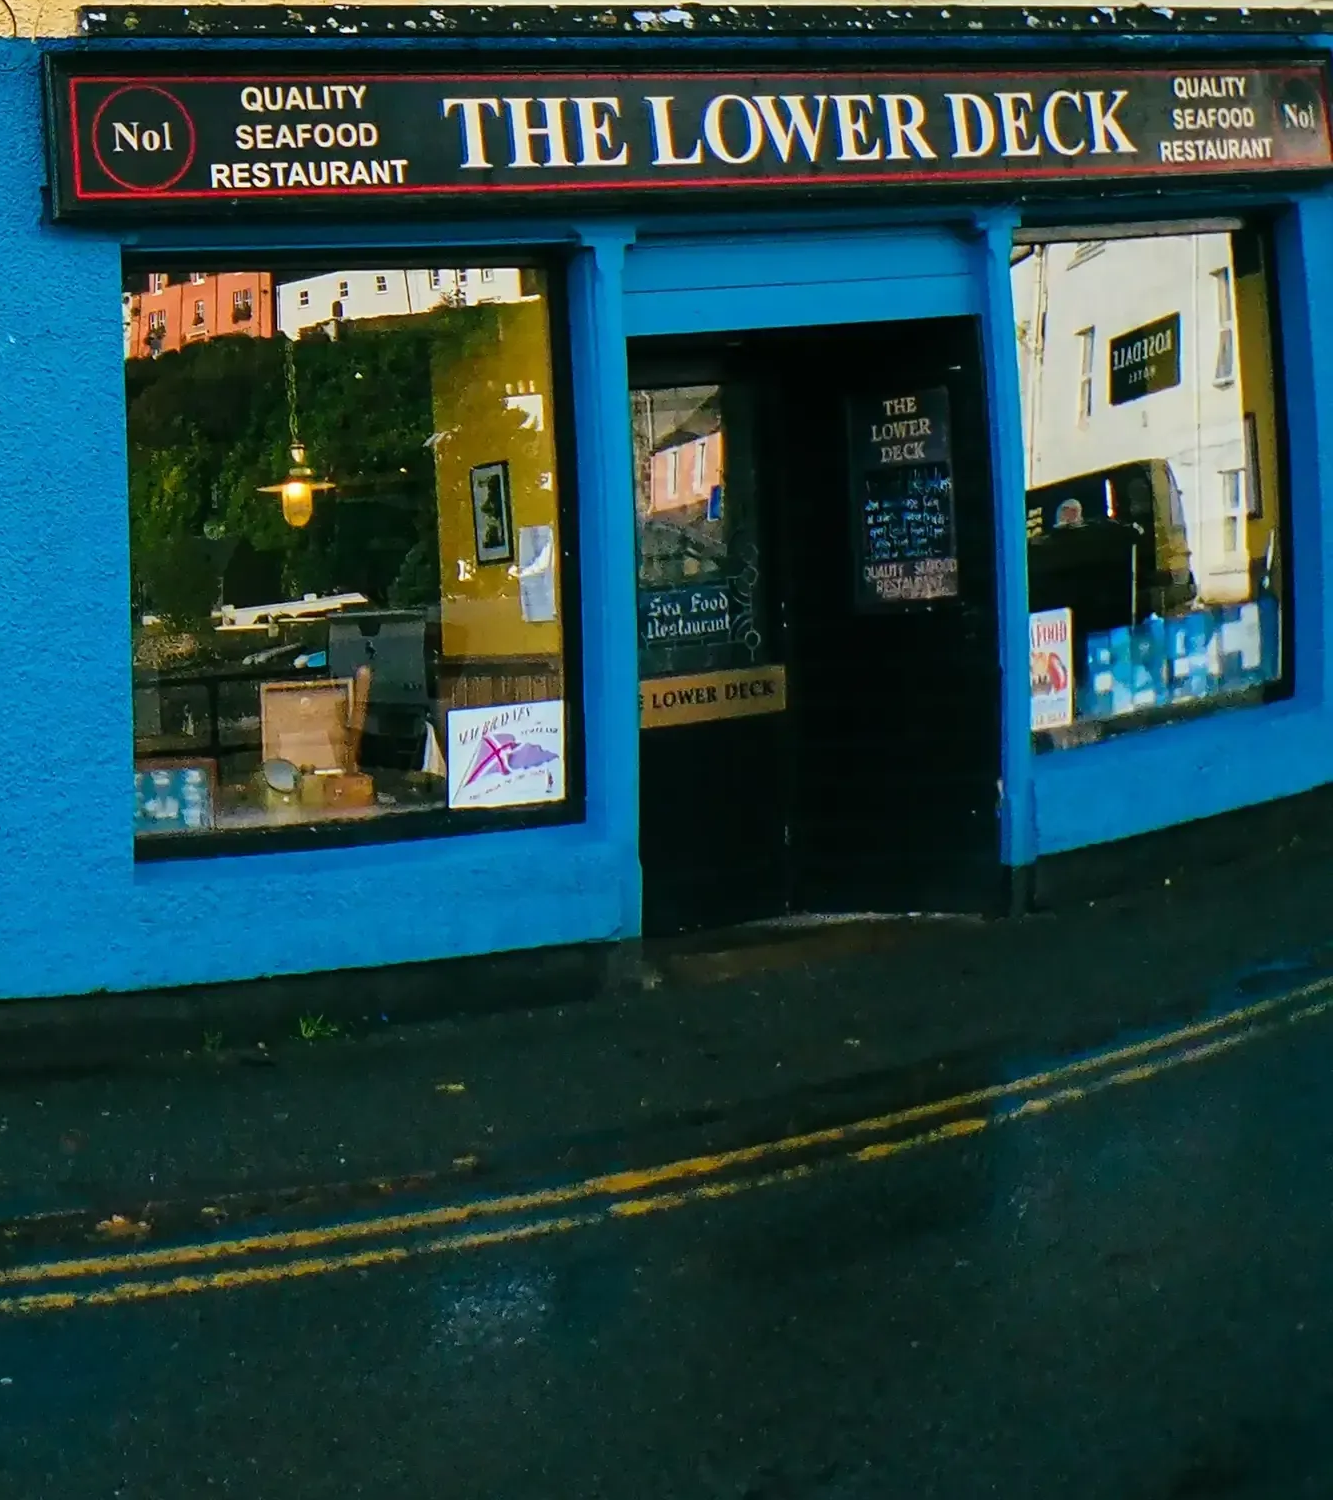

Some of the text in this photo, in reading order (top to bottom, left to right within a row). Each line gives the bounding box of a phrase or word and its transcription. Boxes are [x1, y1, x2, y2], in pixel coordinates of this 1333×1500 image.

[240, 85, 367, 113] QUALITY
[1173, 75, 1246, 99] QUALITY
[440, 90, 1138, 169] THE LOWER DECK
[1172, 107, 1255, 131] SEAFOOD
[235, 122, 379, 151] SEAFOOD
[1160, 137, 1273, 163] RESTAURANT
[210, 159, 409, 189] RESTAURANT
[882, 396, 917, 416] THE
[870, 417, 932, 443] LOWER
[880, 441, 926, 464] DECK
[648, 591, 729, 617] Sea Food
[646, 613, 731, 639] Restaurant
[651, 685, 717, 709] LOWER
[724, 679, 777, 700] DECK
